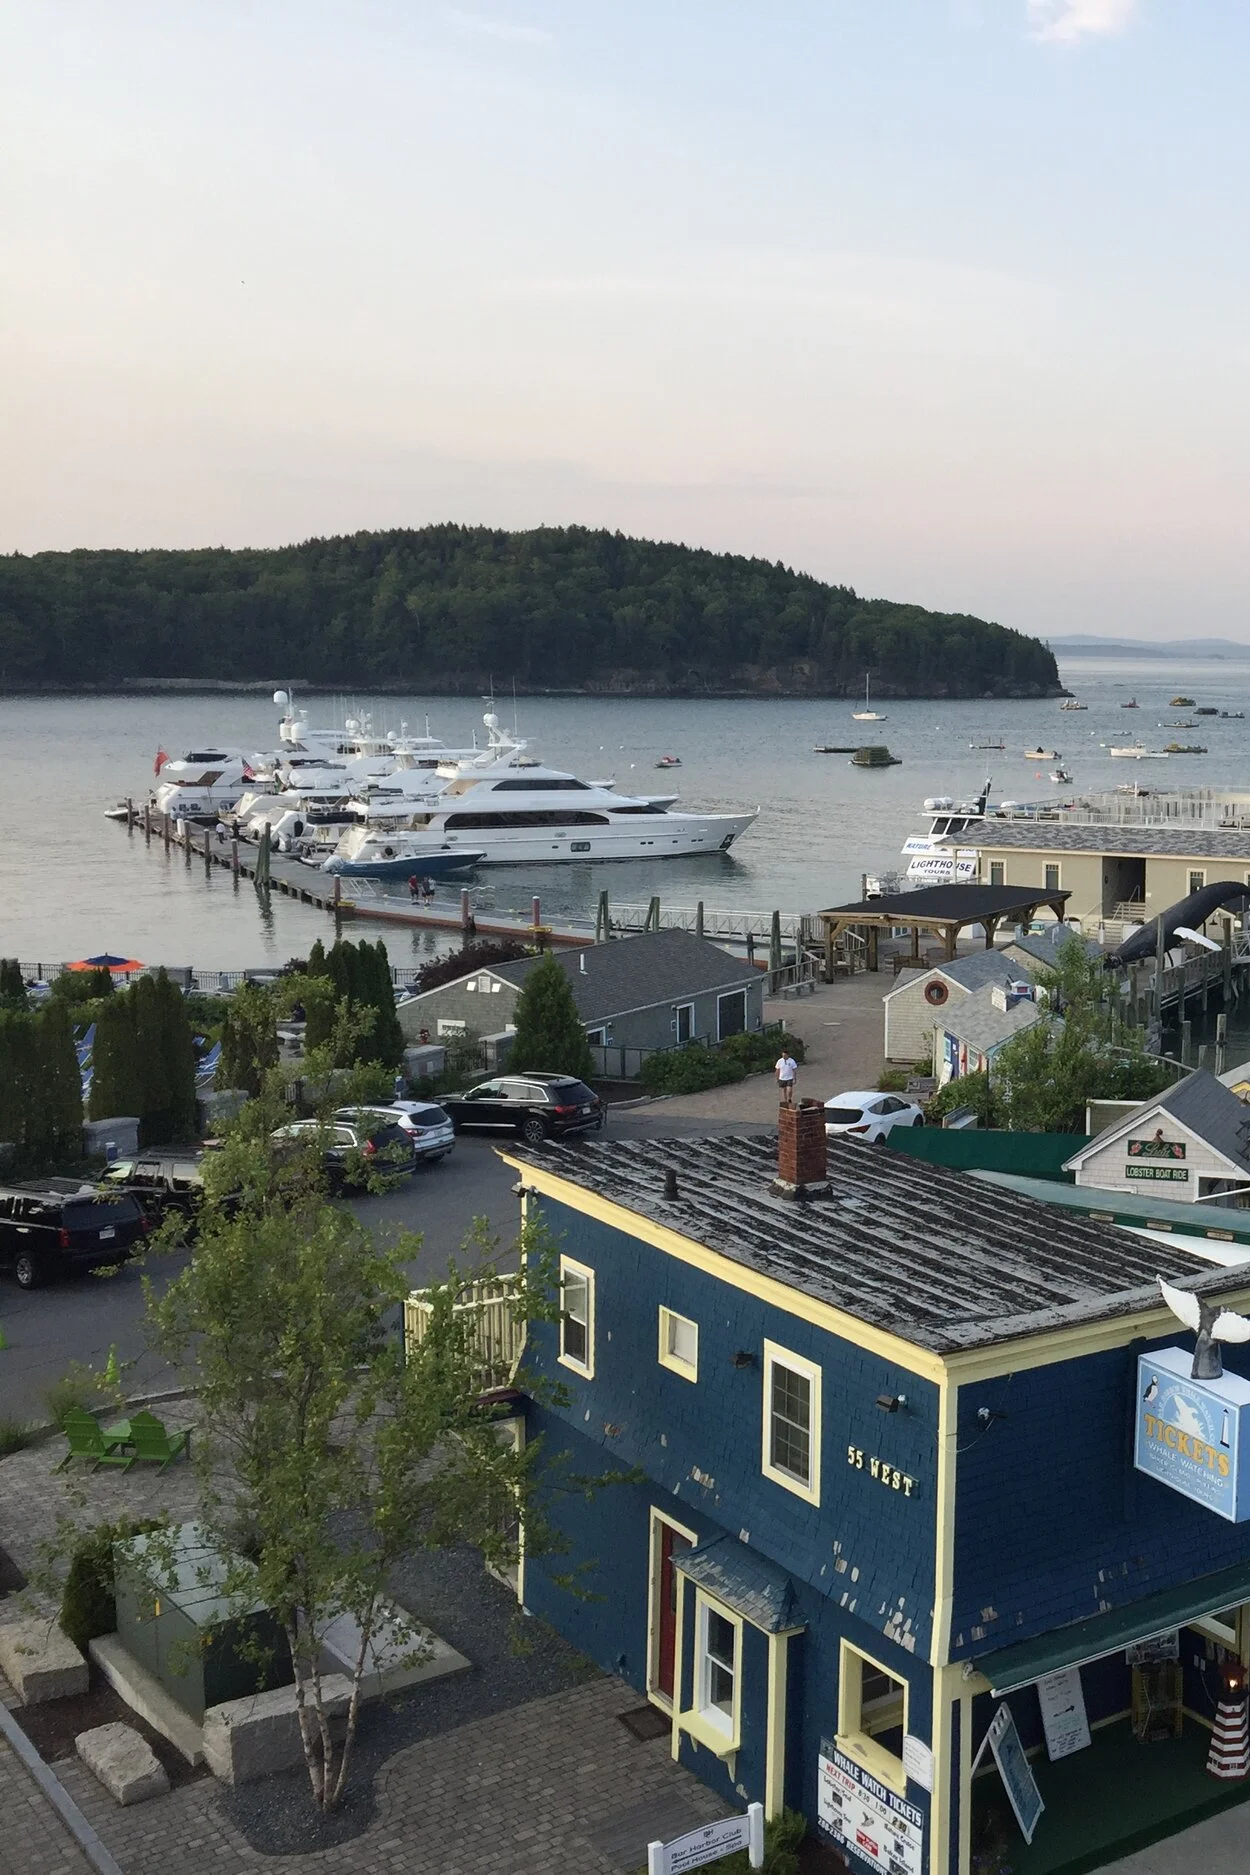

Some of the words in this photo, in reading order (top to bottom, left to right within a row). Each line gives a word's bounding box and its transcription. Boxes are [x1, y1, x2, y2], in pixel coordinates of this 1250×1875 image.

[1126, 1166, 1154, 1178] LOBSTER
[1155, 1168, 1172, 1179] BOAT
[1172, 1170, 1187, 1180] RIDE
[1144, 1412, 1230, 1478] TICKETS
[1148, 1441, 1177, 1462] WHALE
[1180, 1458, 1224, 1488] WATCHING
[847, 1445, 864, 1470] 55
[870, 1457, 913, 1497] WEST
[826, 1763, 841, 1780] NEXT
[841, 1775, 856, 1791] TRIP
[833, 1750, 860, 1781] WHALE
[861, 1771, 887, 1803] WATCH
[888, 1792, 922, 1828] TICKETS
[671, 1850, 687, 1860] Bar
[689, 1837, 720, 1852] Harbor
[722, 1828, 742, 1841] Club
[671, 1859, 690, 1872] Pool
[691, 1849, 718, 1864] House
[725, 1840, 742, 1852] Spa
